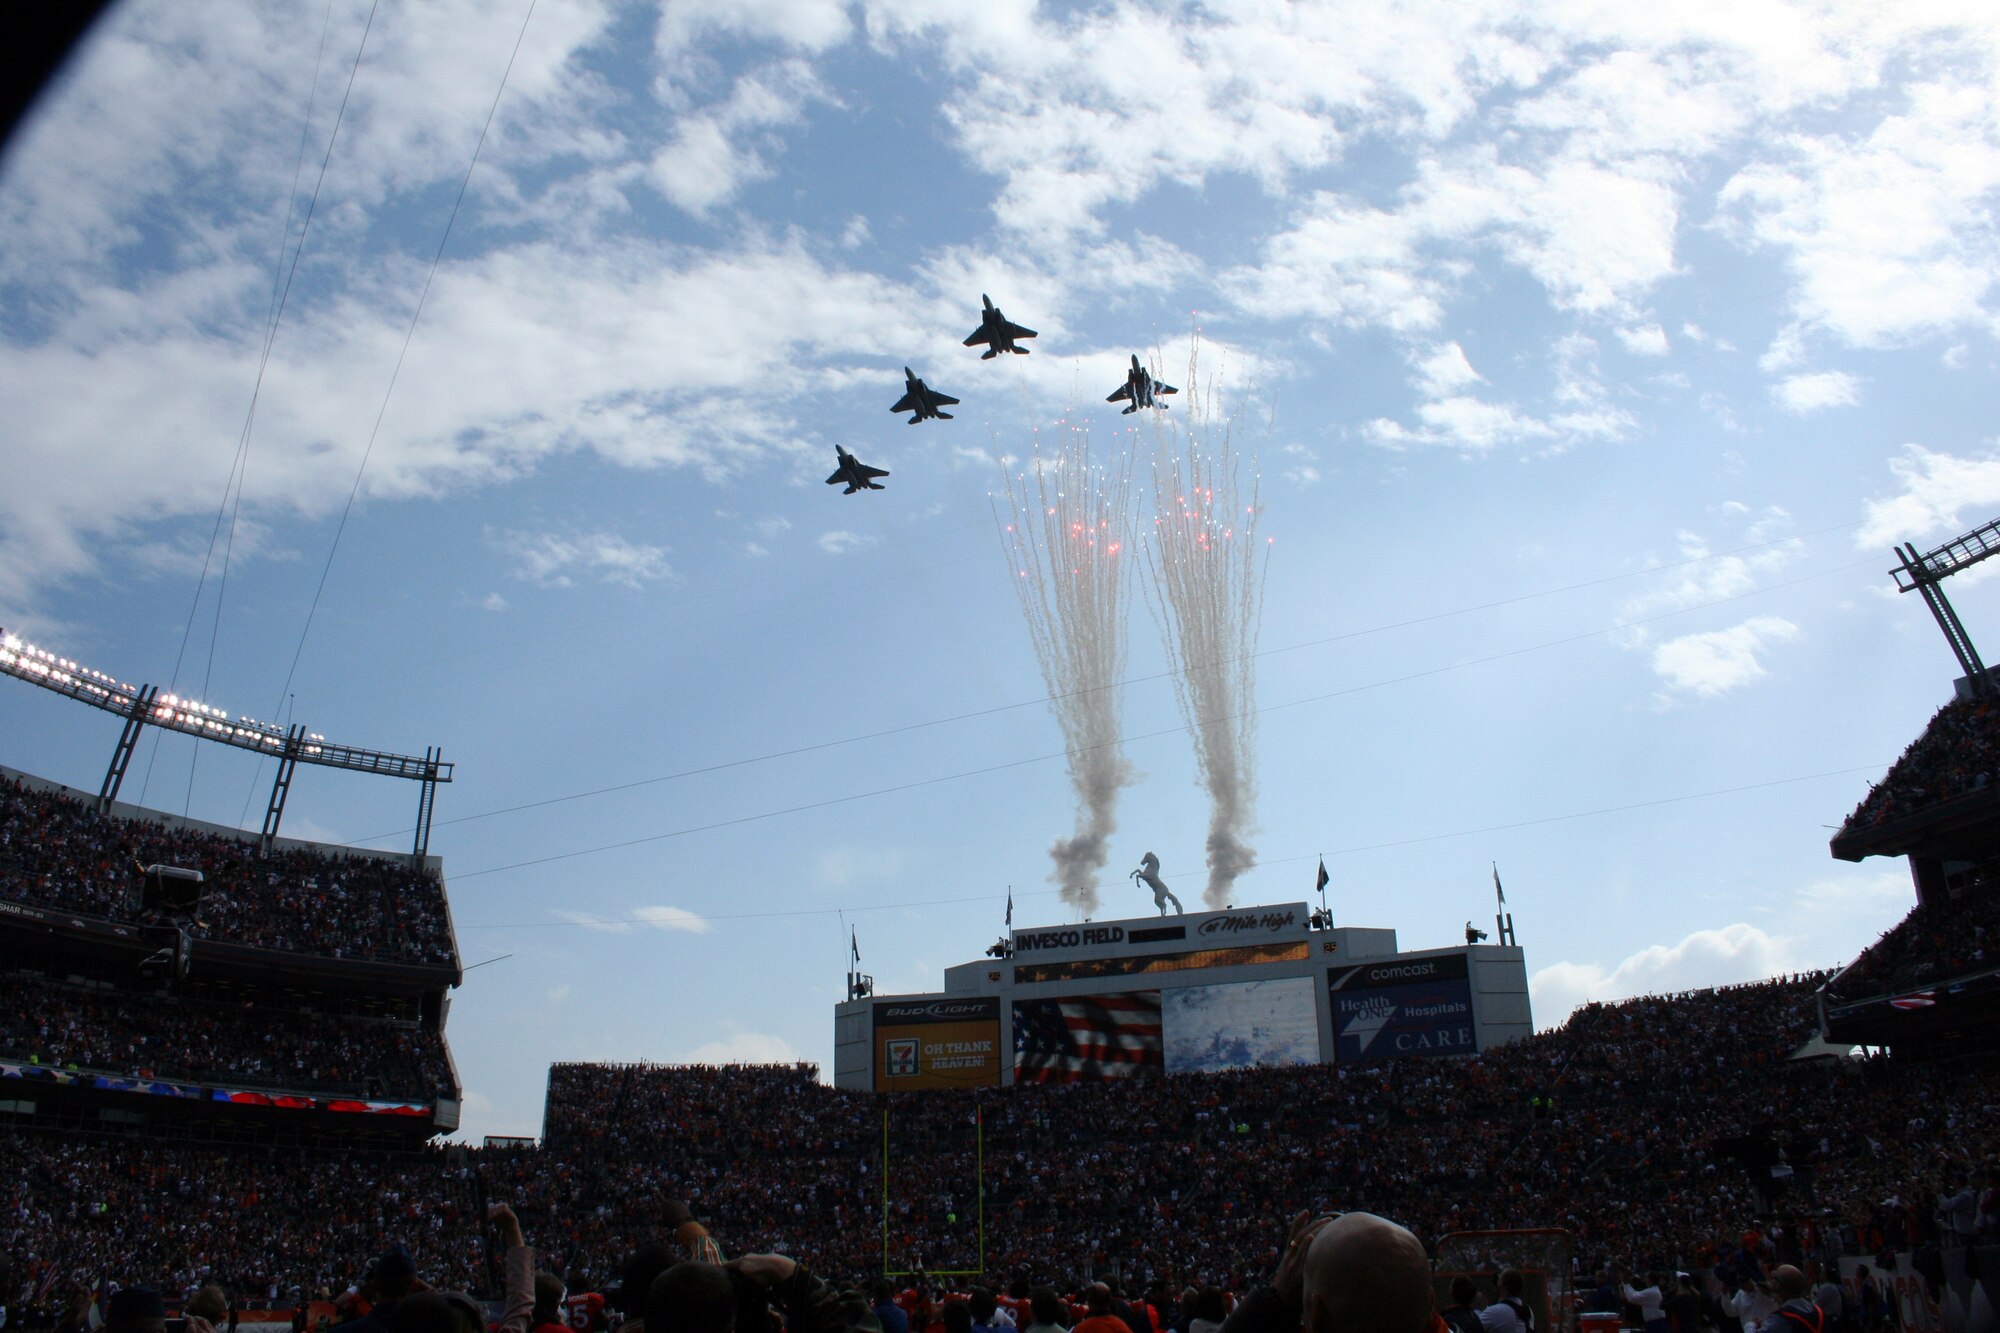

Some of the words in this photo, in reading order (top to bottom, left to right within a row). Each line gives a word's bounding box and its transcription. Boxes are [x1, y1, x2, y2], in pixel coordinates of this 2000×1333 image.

[1222, 914, 1258, 931] Mile
[1260, 911, 1294, 932] High
[1016, 930, 1080, 951] INVESCO
[1083, 926, 1125, 945] FIELD
[1371, 962, 1435, 980] comcast
[886, 1007, 925, 1016] BUD
[934, 1004, 988, 1013] LIGHT
[1340, 996, 1390, 1012] Health
[1404, 1002, 1467, 1018] Hospitals
[1357, 1006, 1390, 1020] ONE
[1396, 1027, 1472, 1051] CARE
[924, 1043, 944, 1055] OH
[946, 1041, 992, 1054] THANK
[932, 1055, 985, 1069] HEAVEN!
